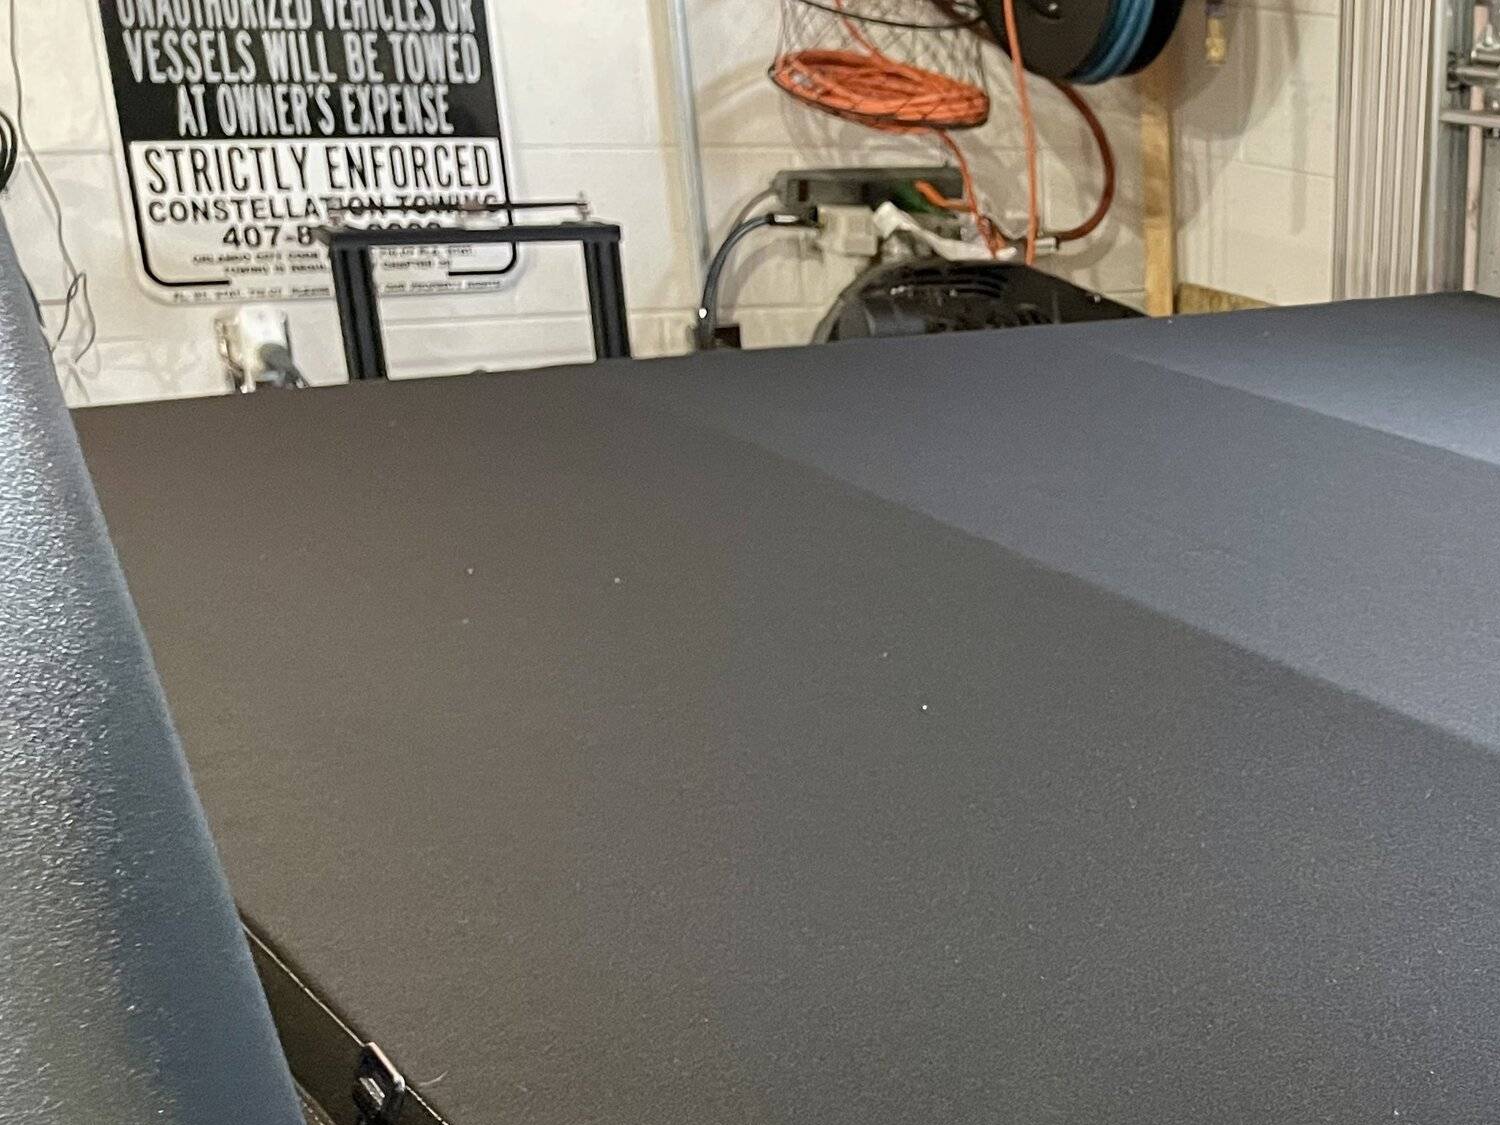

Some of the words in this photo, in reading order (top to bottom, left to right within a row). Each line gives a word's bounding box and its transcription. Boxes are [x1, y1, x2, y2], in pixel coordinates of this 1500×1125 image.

[441, 0, 475, 33] OR
[122, 30, 256, 83] VESSELS
[262, 31, 338, 83] WILL
[344, 32, 384, 83] BE
[387, 33, 481, 84] TOWED
[177, 86, 208, 136] AT
[216, 85, 335, 135] OWNER'S
[340, 84, 454, 134] EXPENSE
[144, 147, 309, 195] STRICTLY
[325, 144, 493, 190] ENFORCED
